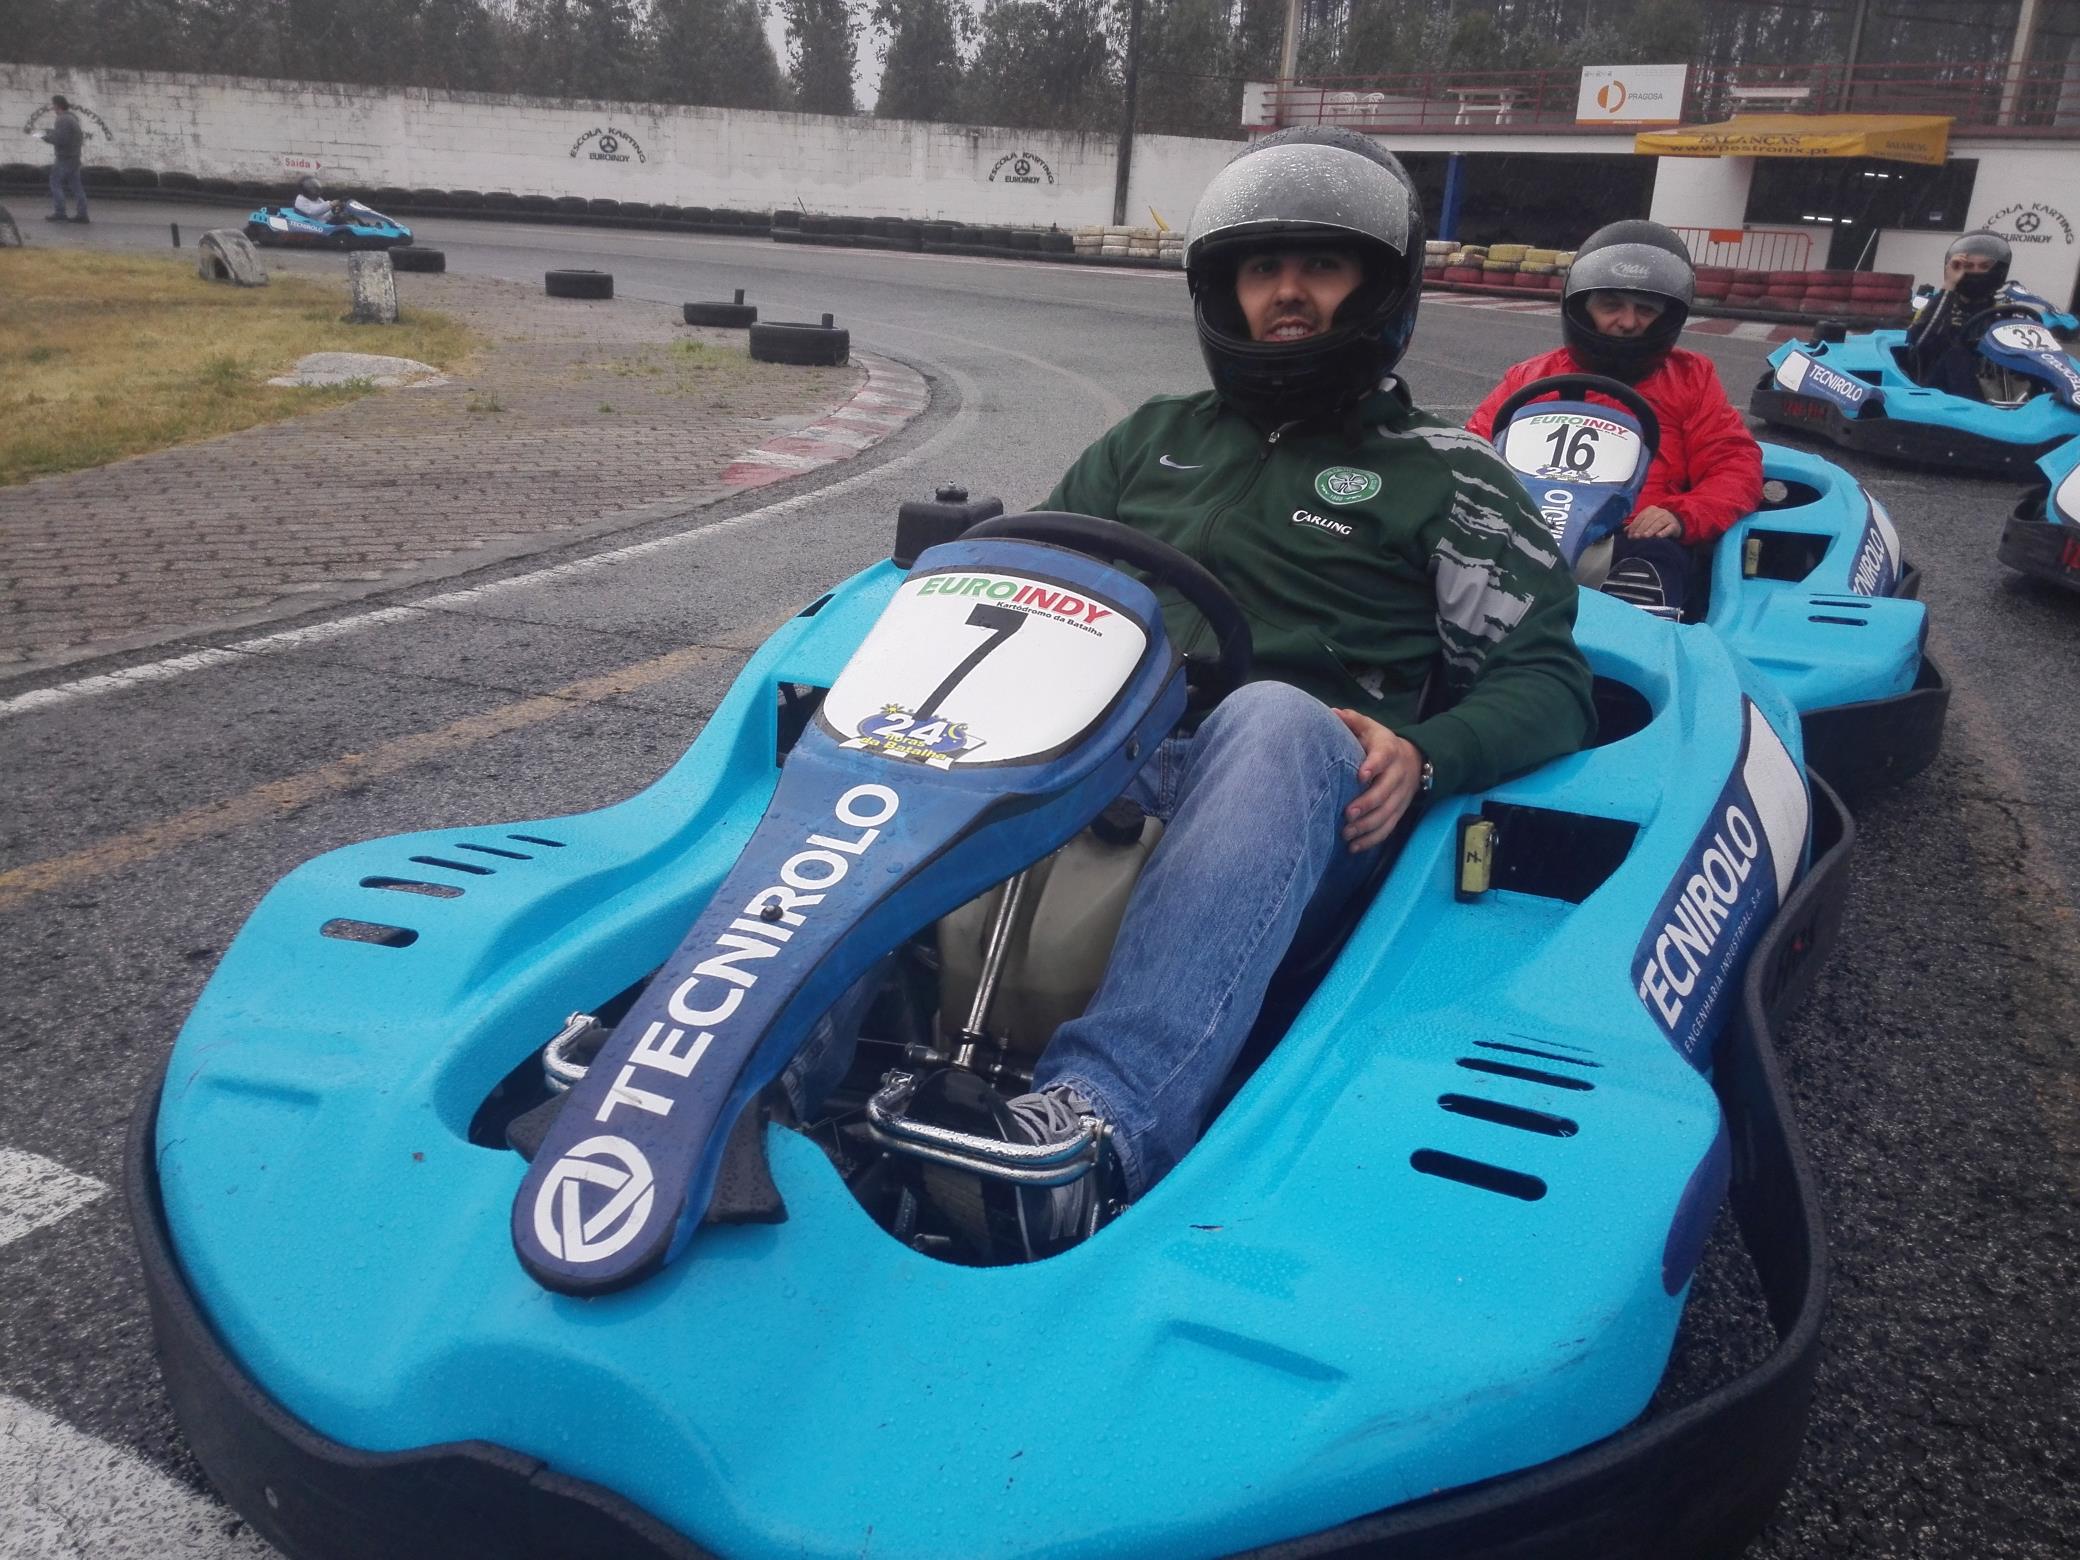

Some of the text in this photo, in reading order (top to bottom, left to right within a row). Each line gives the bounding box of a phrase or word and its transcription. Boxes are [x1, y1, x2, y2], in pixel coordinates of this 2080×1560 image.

[1628, 93, 1664, 101] PRAGOSA
[569, 127, 647, 164] ESCOLA KARTING
[589, 152, 631, 163] EUROINDY
[988, 151, 1055, 185] ESCOLA KARTING
[1004, 175, 1041, 184] EUROINDY
[2032, 202, 2074, 245] KARTING
[2012, 329, 2049, 350] 32
[1809, 364, 1863, 402] TECNIROLO
[1529, 415, 1630, 435] EUROINDY
[1546, 423, 1600, 472] 16
[1292, 510, 1353, 535] CARLING
[916, 576, 1113, 624] EUROINDY
[1053, 613, 1066, 623] da
[1066, 618, 1103, 638] Batalha
[911, 603, 1029, 721] 7
[872, 713, 948, 746] 24
[859, 737, 948, 760] da Batalha
[594, 783, 899, 1123] TECNIROLO
[1684, 975, 1724, 1053] ENGENHARIA
